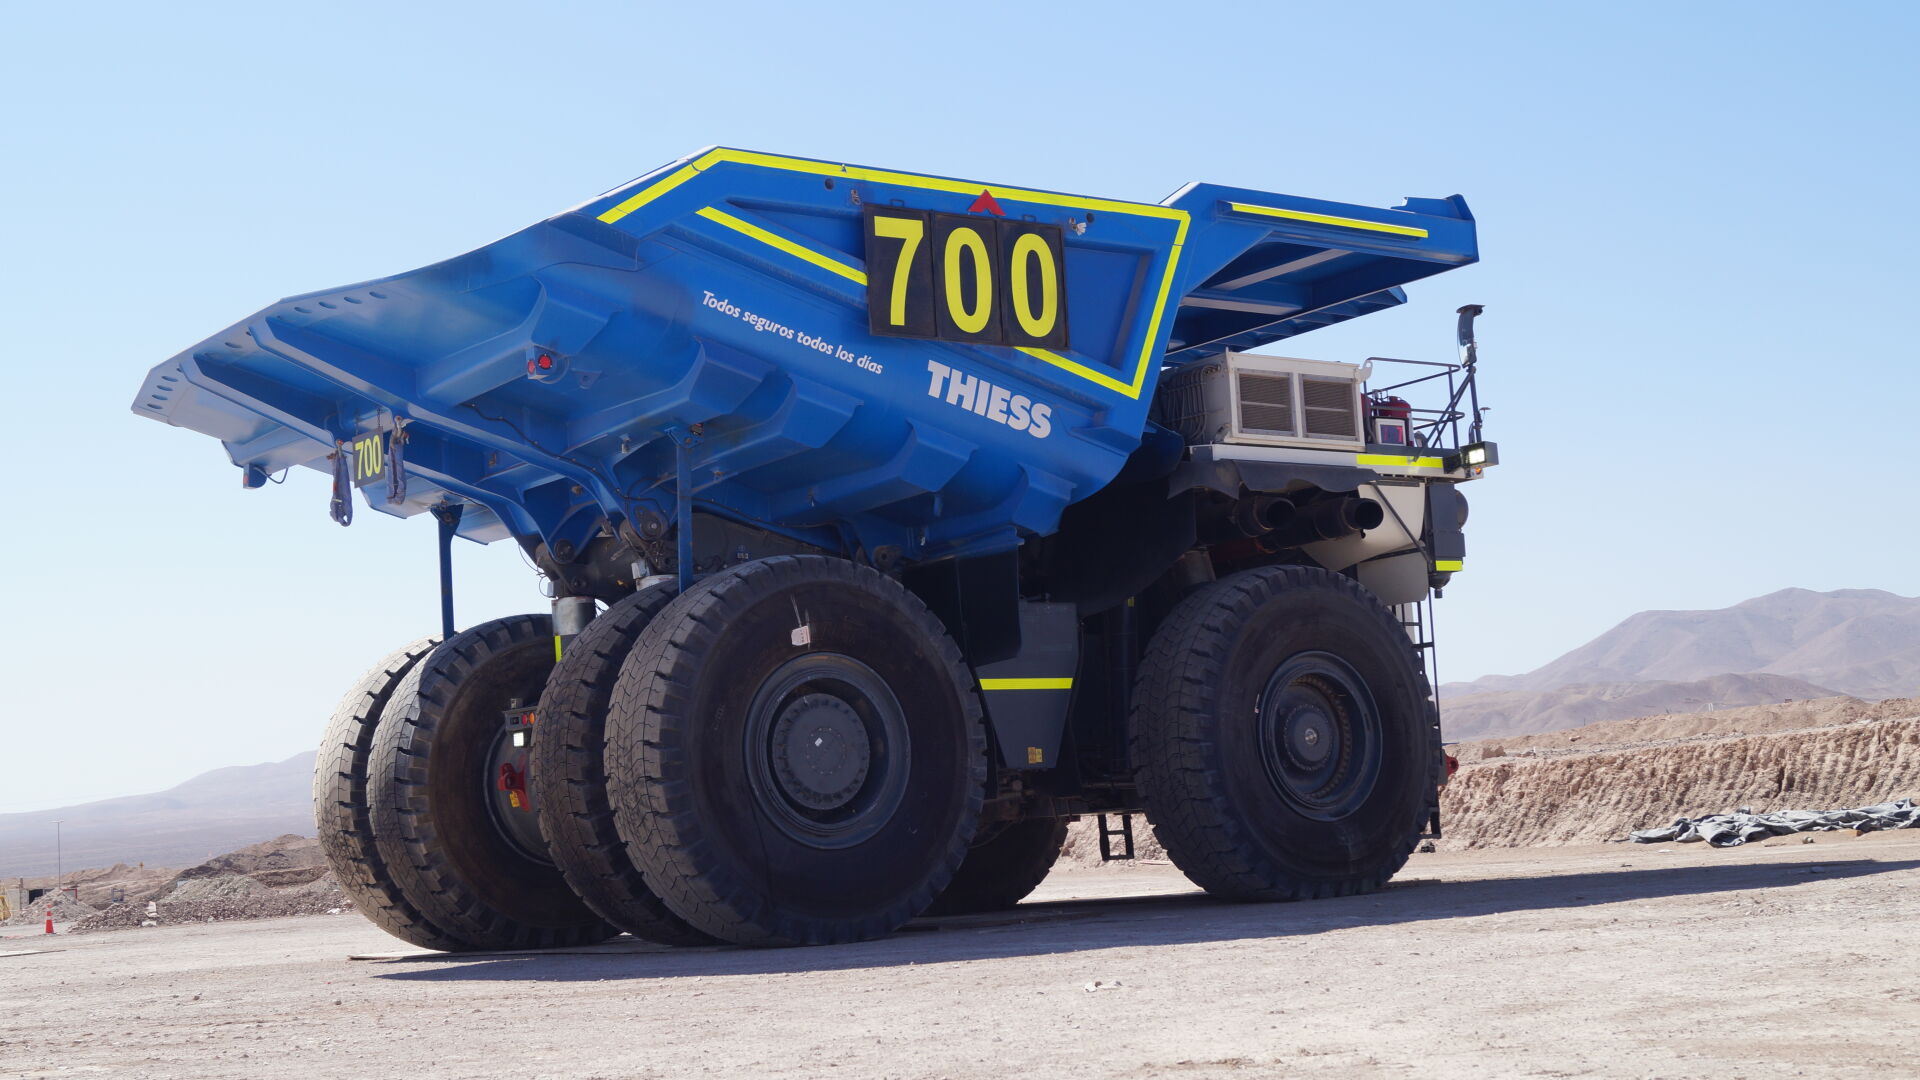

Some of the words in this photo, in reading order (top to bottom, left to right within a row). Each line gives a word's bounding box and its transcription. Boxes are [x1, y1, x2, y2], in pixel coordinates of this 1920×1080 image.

[874, 215, 1057, 338] 700
[703, 290, 741, 318] Todos
[742, 311, 794, 339] seguros
[797, 331, 834, 355] todos
[835, 344, 855, 363] los
[856, 354, 883, 374] días
[927, 359, 1052, 439] THIESS
[355, 434, 381, 480] 700
